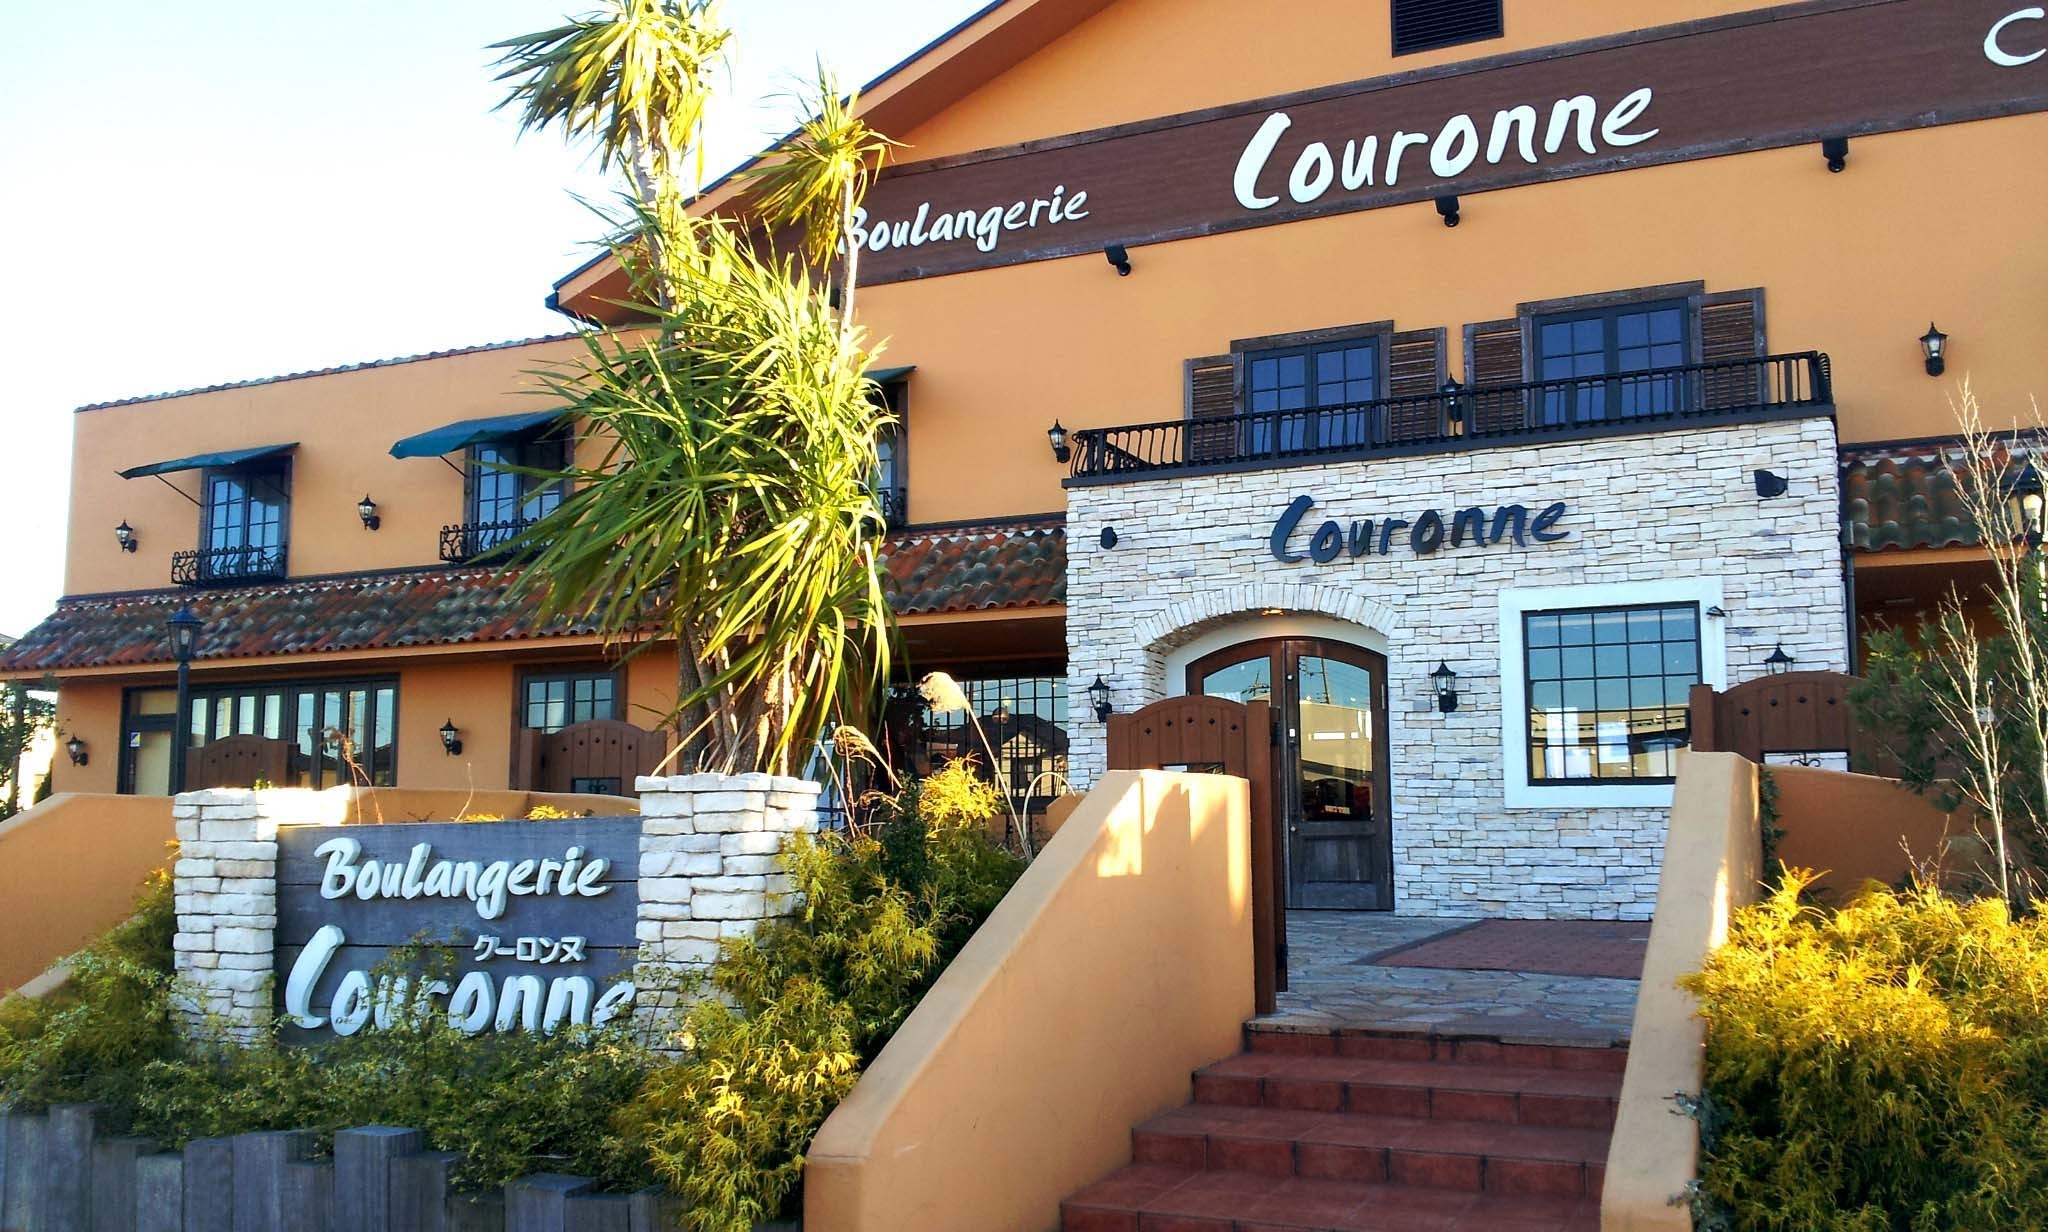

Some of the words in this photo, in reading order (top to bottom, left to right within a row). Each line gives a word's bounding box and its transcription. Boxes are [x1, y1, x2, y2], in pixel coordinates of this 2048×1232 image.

[1233, 87, 1660, 210] Couronne
[837, 184, 1090, 253] Boulangerie
[1269, 494, 1571, 565] Couronne
[315, 837, 611, 920] Boulangerie
[285, 924, 637, 1042] Couronne
[473, 934, 587, 964] クーロンヌ
